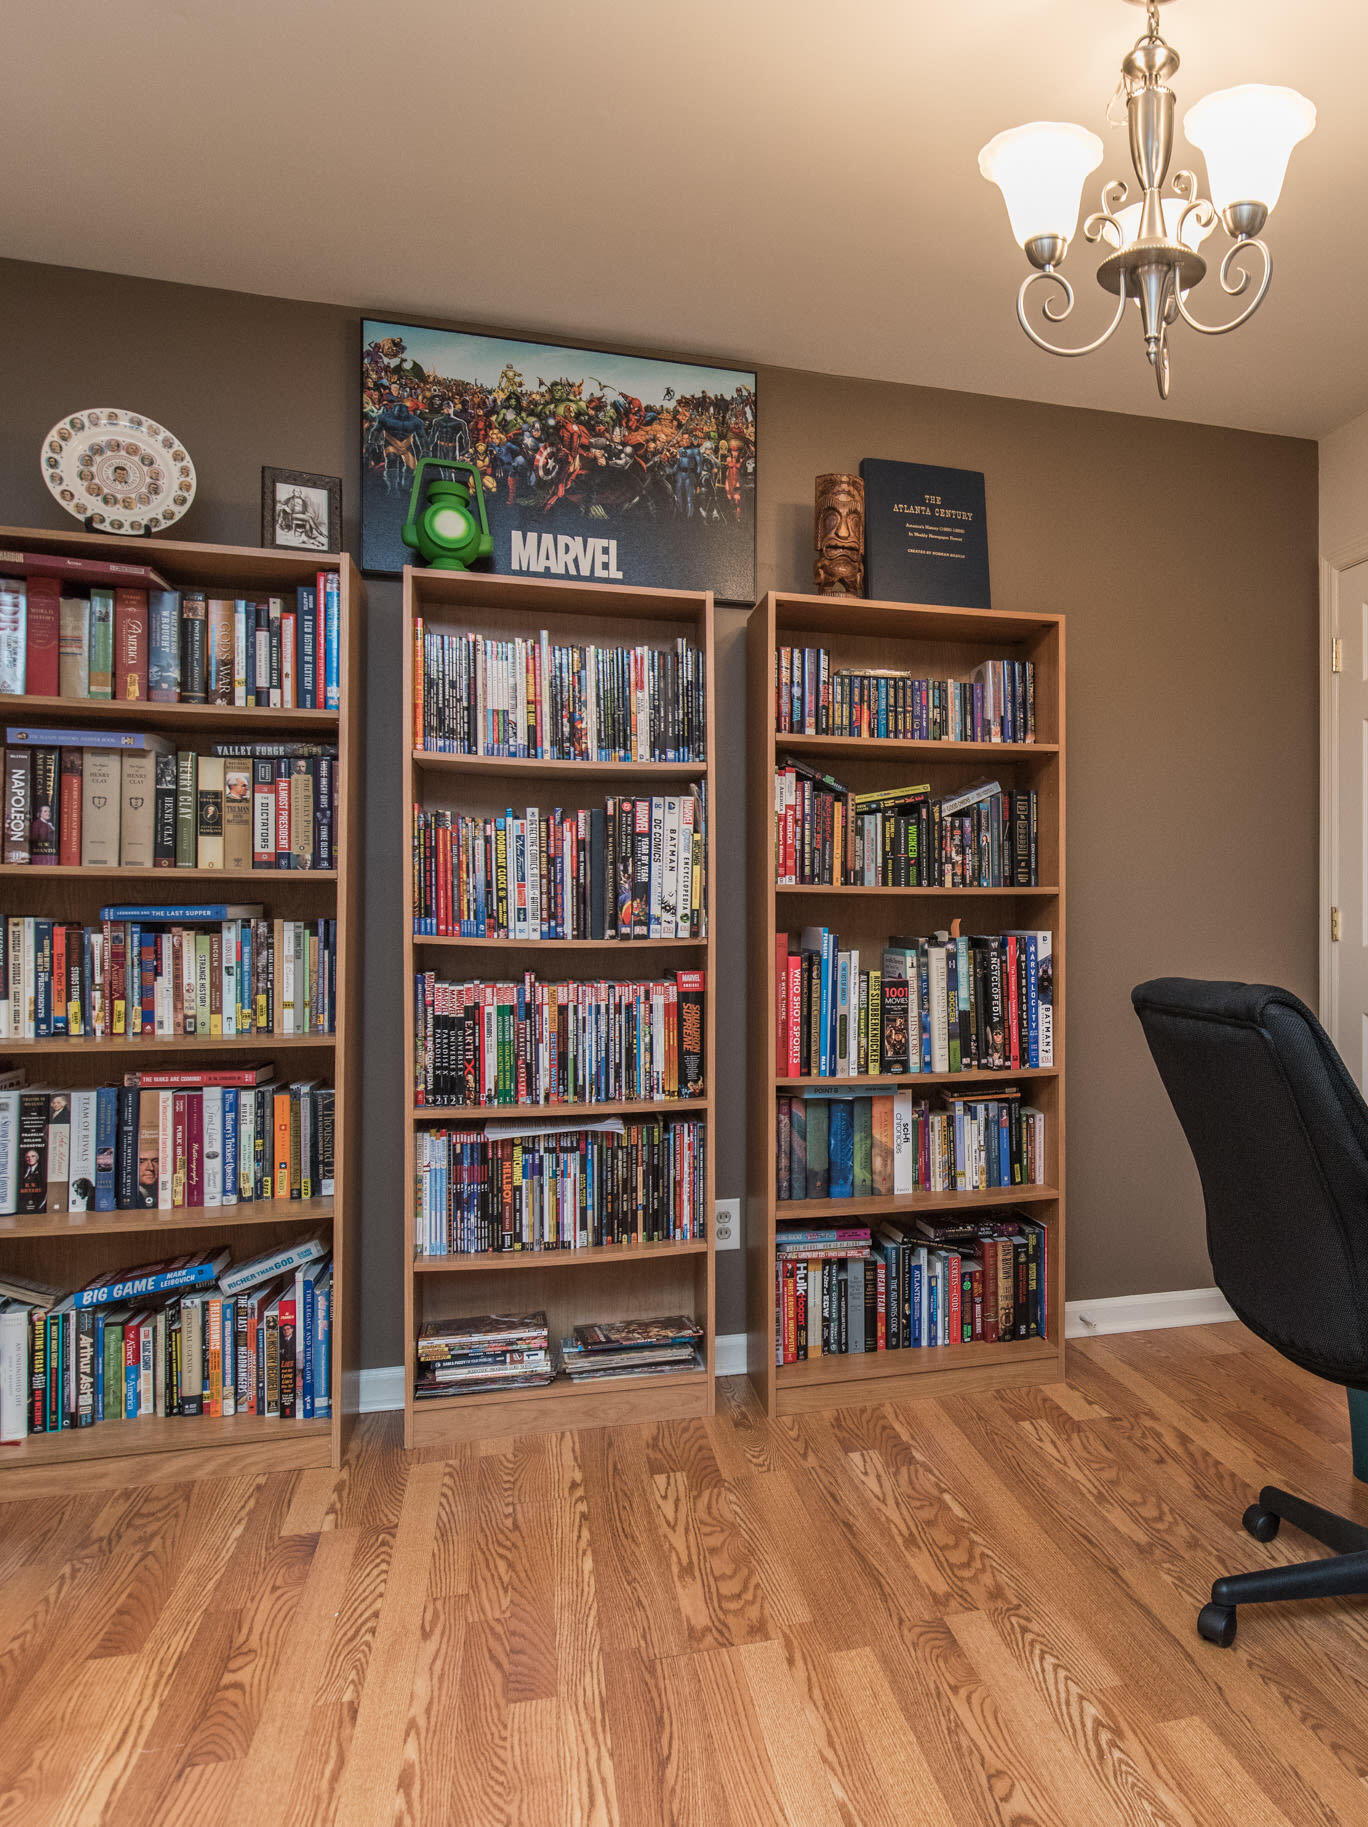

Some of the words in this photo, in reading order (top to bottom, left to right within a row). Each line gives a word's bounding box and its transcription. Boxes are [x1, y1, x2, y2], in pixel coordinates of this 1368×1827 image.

[893, 503, 931, 516] ATLANTA
[934, 508, 974, 521] CENTURY
[924, 494, 942, 505] THE
[511, 530, 624, 579] MARVEL
[161, 610, 170, 653] WROUGHT
[304, 621, 313, 633] NEW
[127, 618, 143, 665] AMERICA
[304, 634, 313, 654] HISTORY
[219, 664, 231, 693] WAR
[304, 663, 313, 690] KENTUCKY
[46, 754, 55, 771] THE
[216, 746, 252, 756] VALLEY
[255, 745, 285, 755] FORGE
[36, 752, 45, 795] AMERICAN
[179, 761, 192, 792] HENRY
[320, 760, 329, 777] THOSE
[46, 772, 55, 795] FIRST
[279, 782, 288, 809] ALMOST
[303, 779, 312, 793] THE
[320, 778, 329, 794] ANGRY
[10, 769, 25, 841] NAPOLEON
[163, 797, 173, 824] HENRY
[179, 796, 192, 820] CLAY
[303, 794, 312, 818] BULLY
[320, 795, 329, 808] DAYS
[260, 802, 269, 849] DICTATORS
[279, 810, 288, 848] PRESIDENT
[636, 801, 648, 833] MARVEL
[653, 818, 662, 831] DC
[163, 826, 173, 846] CLAY
[303, 819, 312, 846] PULPIT
[320, 826, 329, 841] LYNNE
[529, 818, 538, 848] DETECTIVE
[641, 837, 649, 854] YEAR
[908, 825, 917, 857] WICKED
[320, 842, 329, 858] OLSON
[497, 830, 506, 867] DOOMSDAY
[641, 855, 649, 864] BY
[653, 832, 662, 863] COMICS
[668, 828, 676, 872] BATMAN
[497, 868, 506, 889] CLOCK
[641, 865, 649, 882] YEAR
[168, 909, 185, 917] LAST
[187, 908, 211, 916] SUPPER
[529, 896, 538, 921] BATMAN
[56, 953, 65, 970] Dawn
[199, 954, 207, 981] STRANGE
[56, 973, 65, 987] Over
[112, 963, 120, 999] AMERICA
[781, 971, 786, 980] WE
[990, 951, 999, 1022] ENCYCLOPEDIA
[56, 988, 65, 1003] Suez
[199, 983, 207, 1007] HISTORY
[859, 982, 867, 1008] MICHAELS
[884, 987, 908, 998] 1001
[464, 1020, 474, 1059] EARTH
[683, 1002, 692, 1051] SUPREME
[691, 1004, 700, 1053] SQUADRON
[870, 993, 880, 1064] SLOBBERKNOCKER
[911, 1015, 919, 1057] HISTORY
[81, 1097, 90, 1118] TEAM
[81, 1121, 90, 1132] OF
[224, 1112, 234, 1138] History's
[895, 1112, 903, 1154] chronicles
[902, 1122, 910, 1143] sci-fi
[81, 1134, 90, 1162] RIVALS
[224, 1139, 234, 1162] Trickiest
[190, 1143, 199, 1185] Historiography
[224, 1163, 234, 1191] Questions
[513, 1145, 522, 1186] WATCHMEN
[503, 1161, 511, 1203] HELLBOY
[1001, 1244, 1012, 1256] DAN
[160, 1273, 196, 1289] LEIBOVICH
[166, 1268, 187, 1279] MARK
[227, 1273, 257, 1290] RICHER
[256, 1264, 275, 1279] THAN
[275, 1255, 295, 1270] GOD
[797, 1263, 807, 1294] Hulk
[877, 1269, 885, 1292] DREAM
[951, 1258, 959, 1286] SECRETS
[1001, 1257, 1012, 1280] BROWN
[82, 1286, 108, 1305] BIG
[113, 1275, 157, 1299] GAME
[237, 1295, 248, 1308] THE
[951, 1293, 959, 1313] CODE
[797, 1294, 807, 1326] Hogan
[877, 1294, 885, 1313] TEAM
[210, 1302, 220, 1350] FREAKONOMICS
[237, 1316, 248, 1332] LAST
[237, 1346, 248, 1393] HEADBANGERS
[127, 1378, 136, 1410] America
